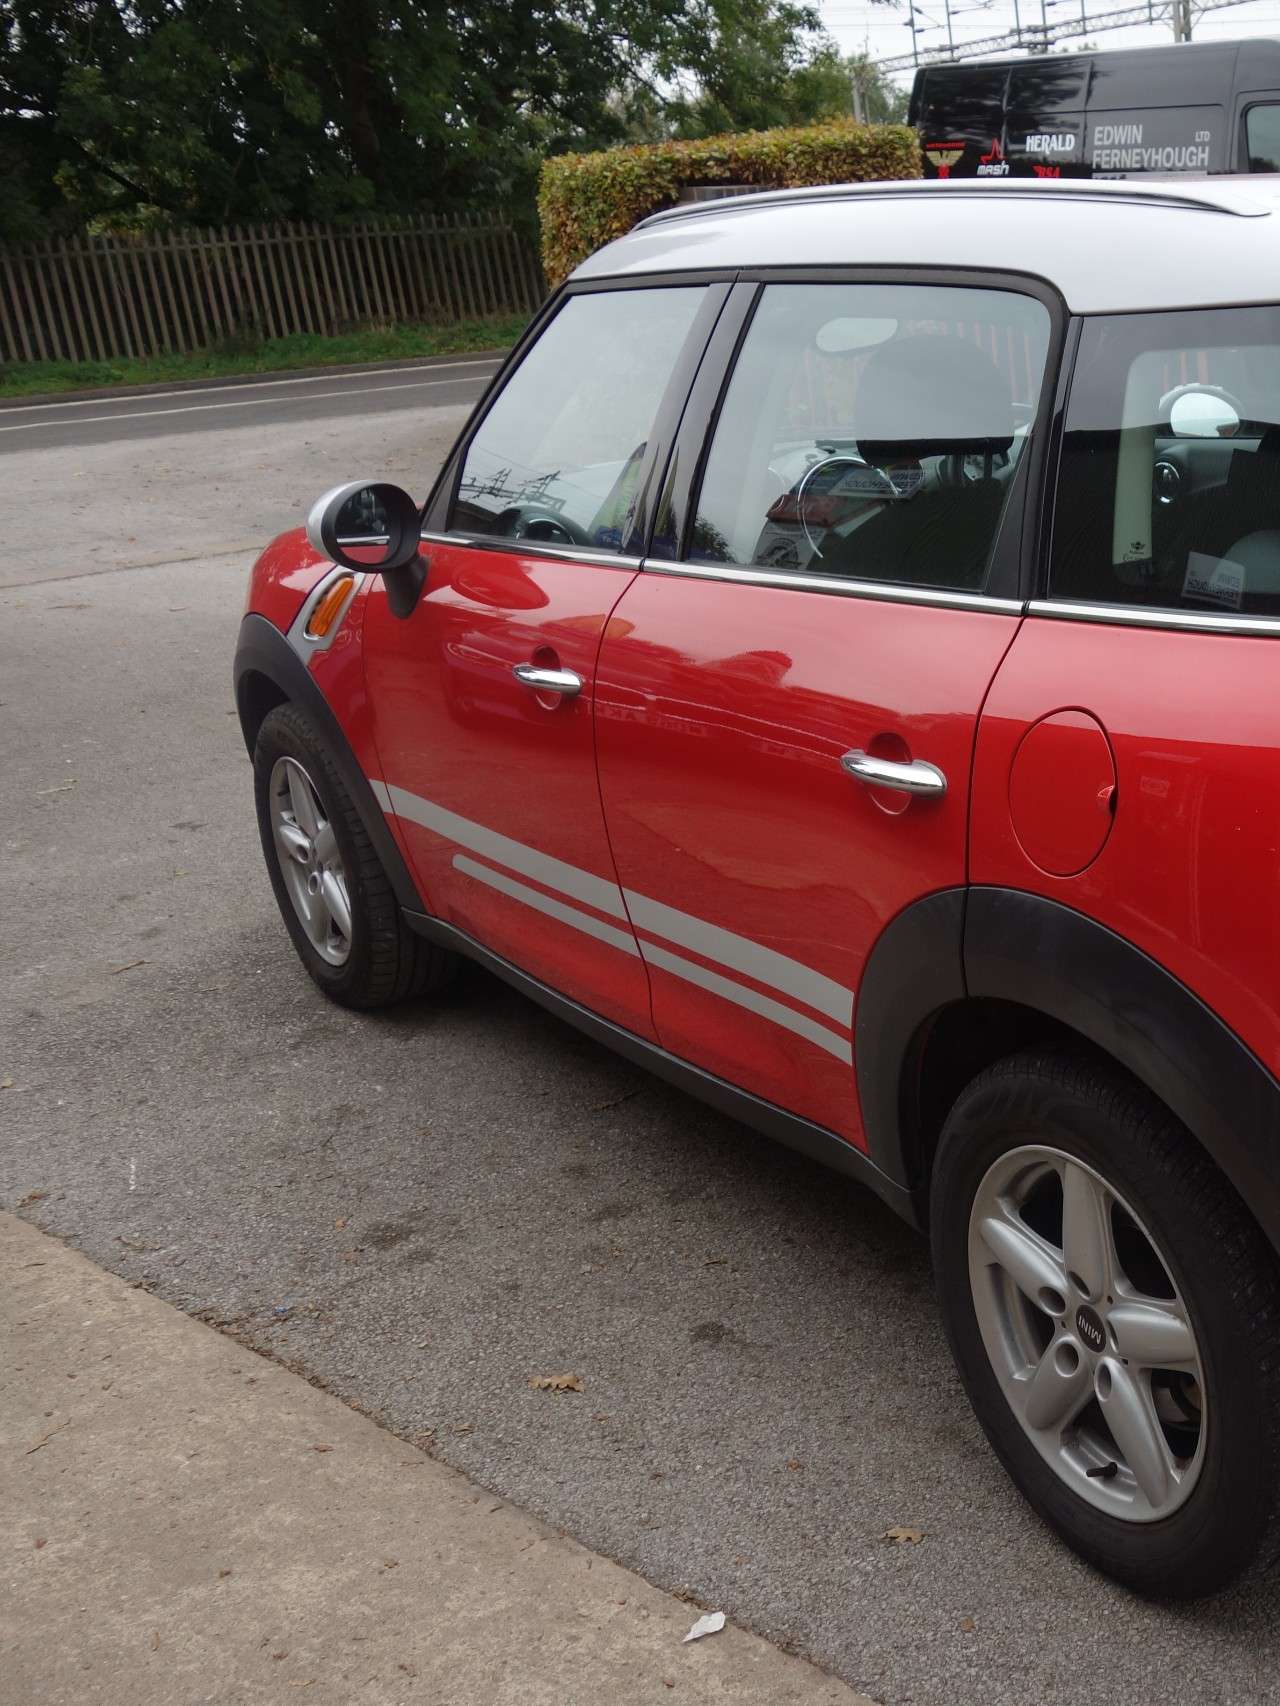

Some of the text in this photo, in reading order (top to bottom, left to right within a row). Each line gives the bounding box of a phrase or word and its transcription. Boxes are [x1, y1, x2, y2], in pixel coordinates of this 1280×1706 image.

[1025, 133, 1076, 155] HERALD
[1094, 124, 1211, 146] EDWIN LTD
[1092, 145, 1209, 170] FERNEYHOUGH
[1078, 1314, 1101, 1345] MINI
